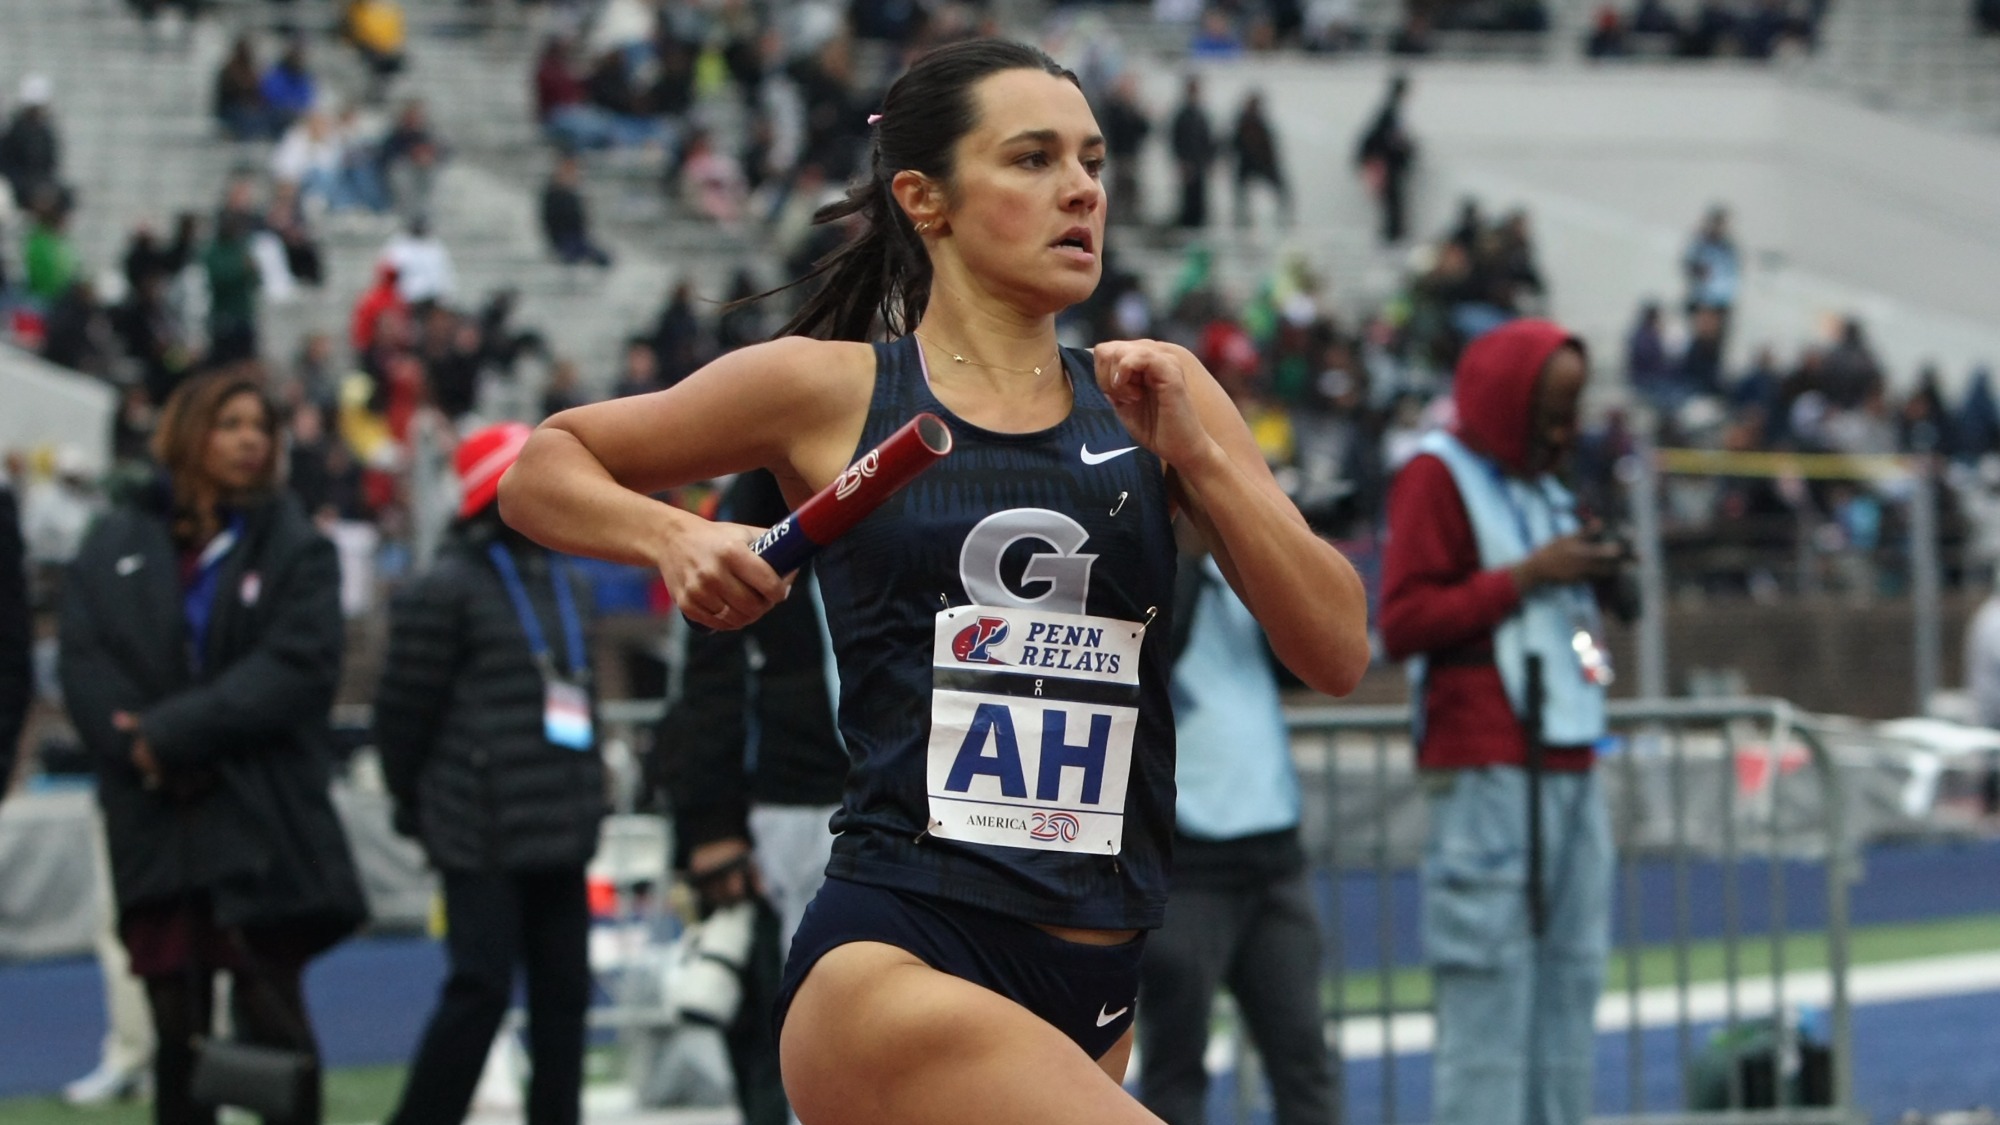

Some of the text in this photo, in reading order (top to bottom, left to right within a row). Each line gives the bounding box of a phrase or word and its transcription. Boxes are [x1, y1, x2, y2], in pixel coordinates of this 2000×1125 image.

[748, 516, 791, 555] LAYS
[958, 507, 1100, 616] G
[1025, 621, 1104, 649] PENN
[1018, 645, 1121, 674] RELAYS
[944, 703, 1113, 805] AH
[966, 812, 1080, 843] AMERICA 250
